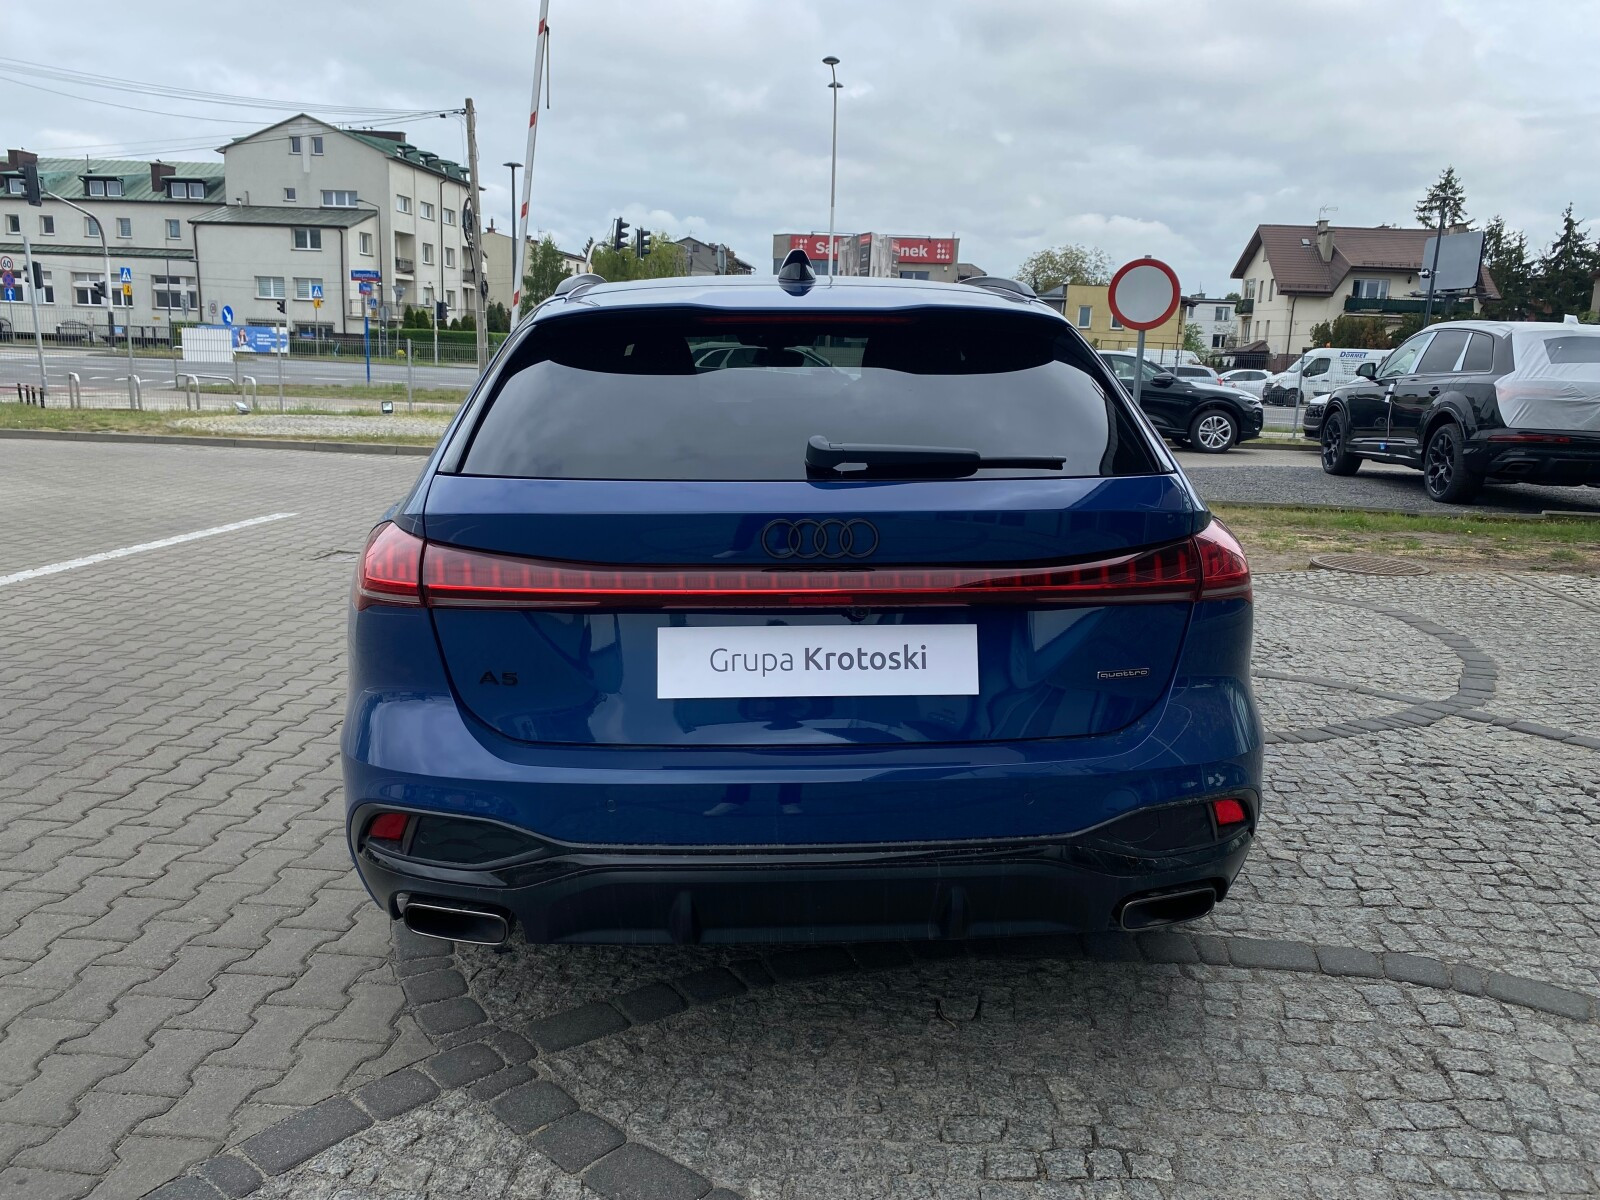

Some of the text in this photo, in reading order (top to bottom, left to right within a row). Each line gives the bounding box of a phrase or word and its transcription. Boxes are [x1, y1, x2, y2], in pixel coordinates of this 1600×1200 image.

[3, 259, 11, 268] 60
[710, 644, 927, 677] Grupa Krotoski
[479, 670, 518, 687] A5
[1100, 670, 1148, 679] quattro
